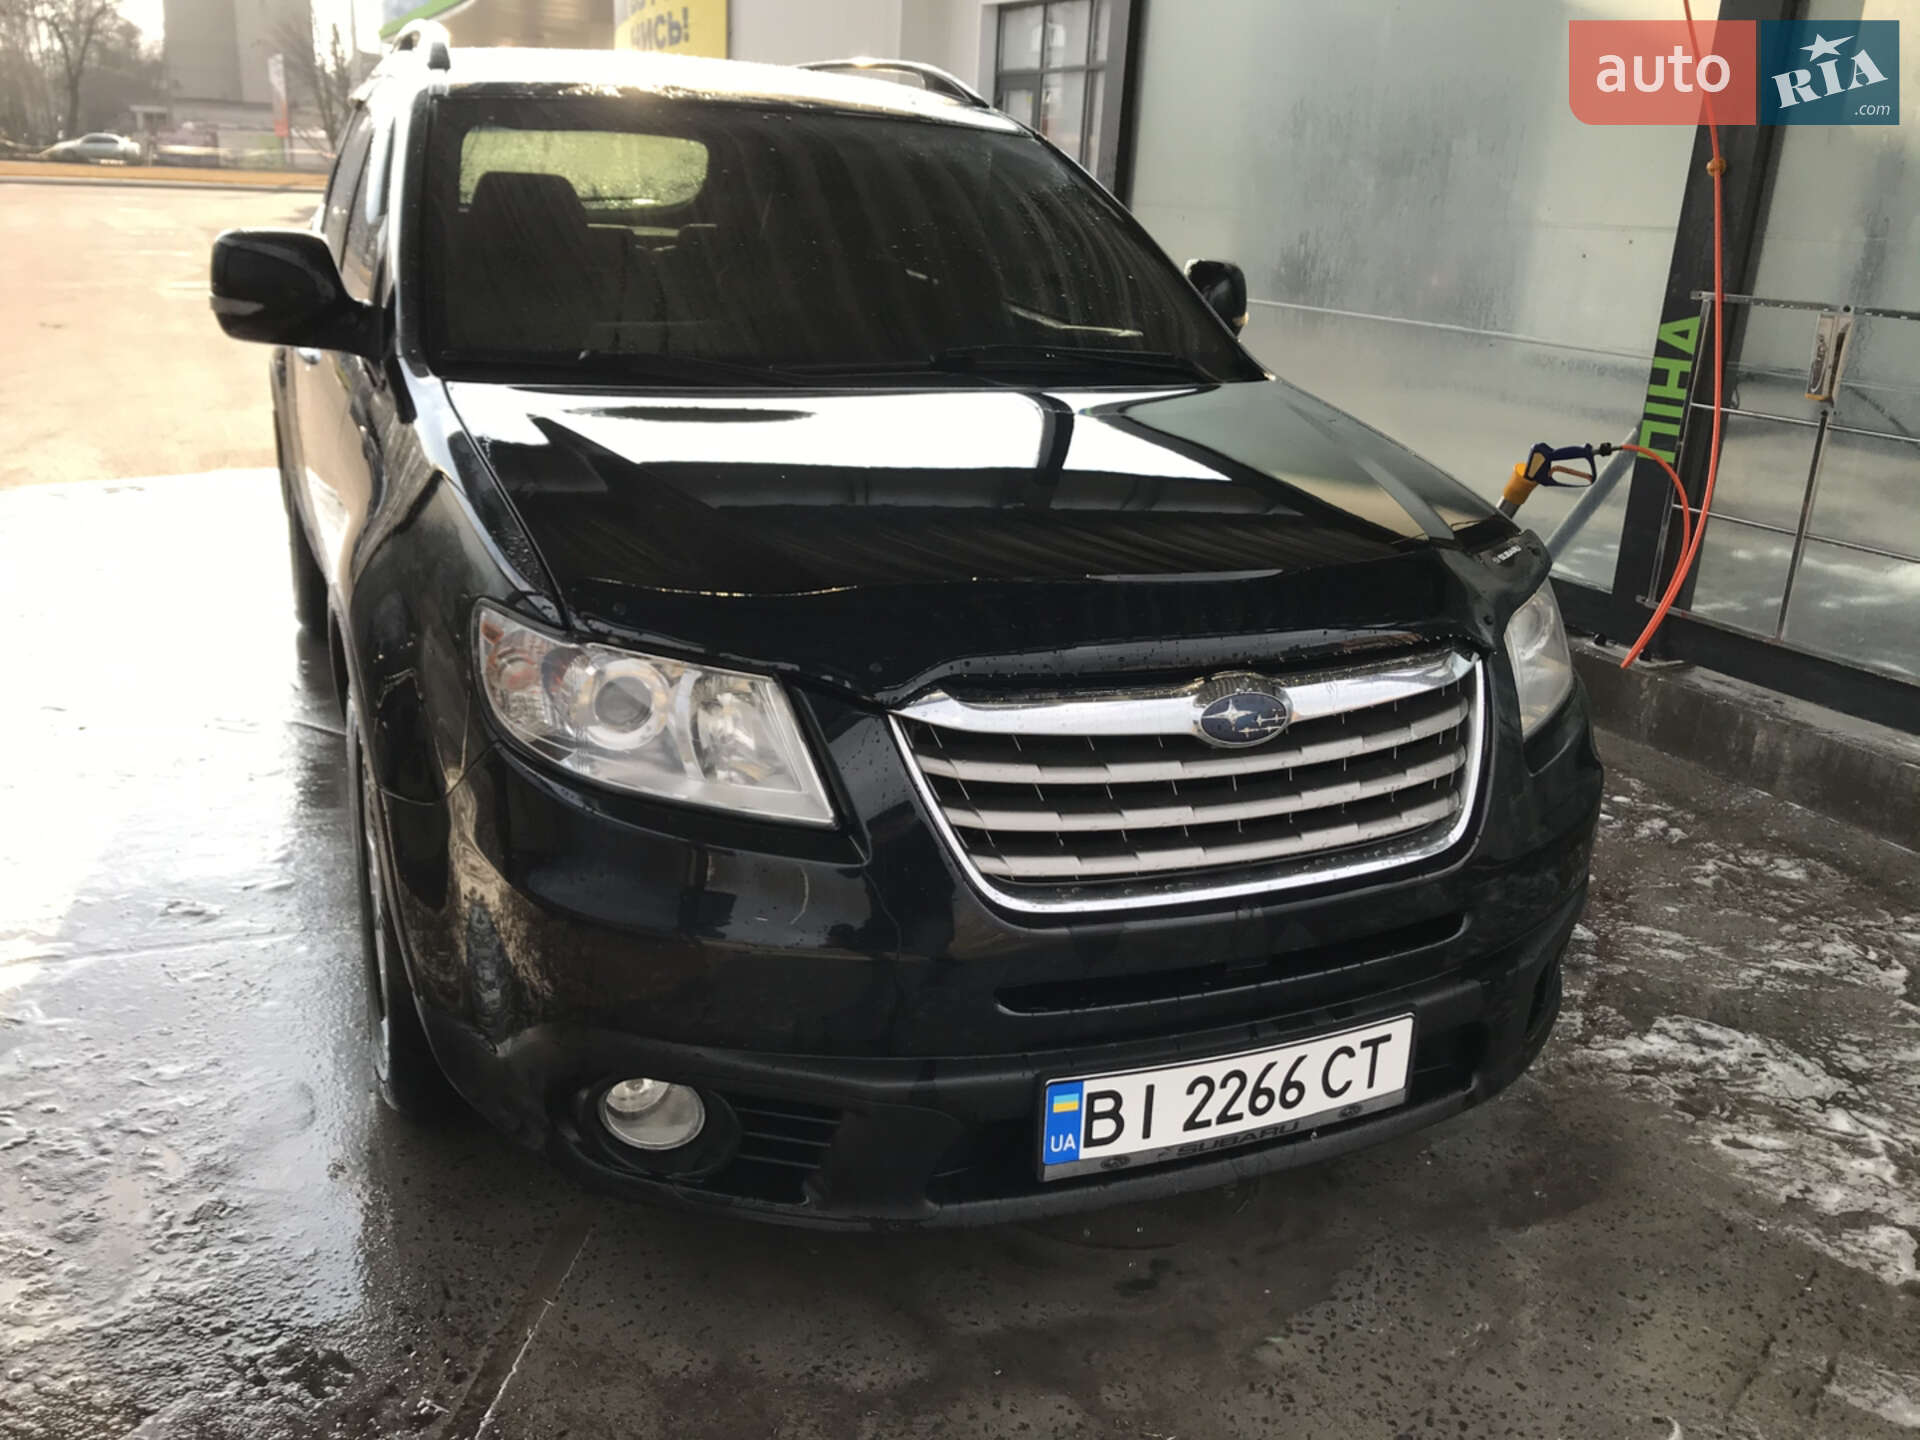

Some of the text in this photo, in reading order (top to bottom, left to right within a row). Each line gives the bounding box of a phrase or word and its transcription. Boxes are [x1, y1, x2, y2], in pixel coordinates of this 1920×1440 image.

[1636, 315, 1701, 464] ПІНА
[1083, 1033, 1393, 1149] BI 2266 CT
[1050, 1133, 1077, 1152] UA
[1177, 1122, 1300, 1156] SUBARU
